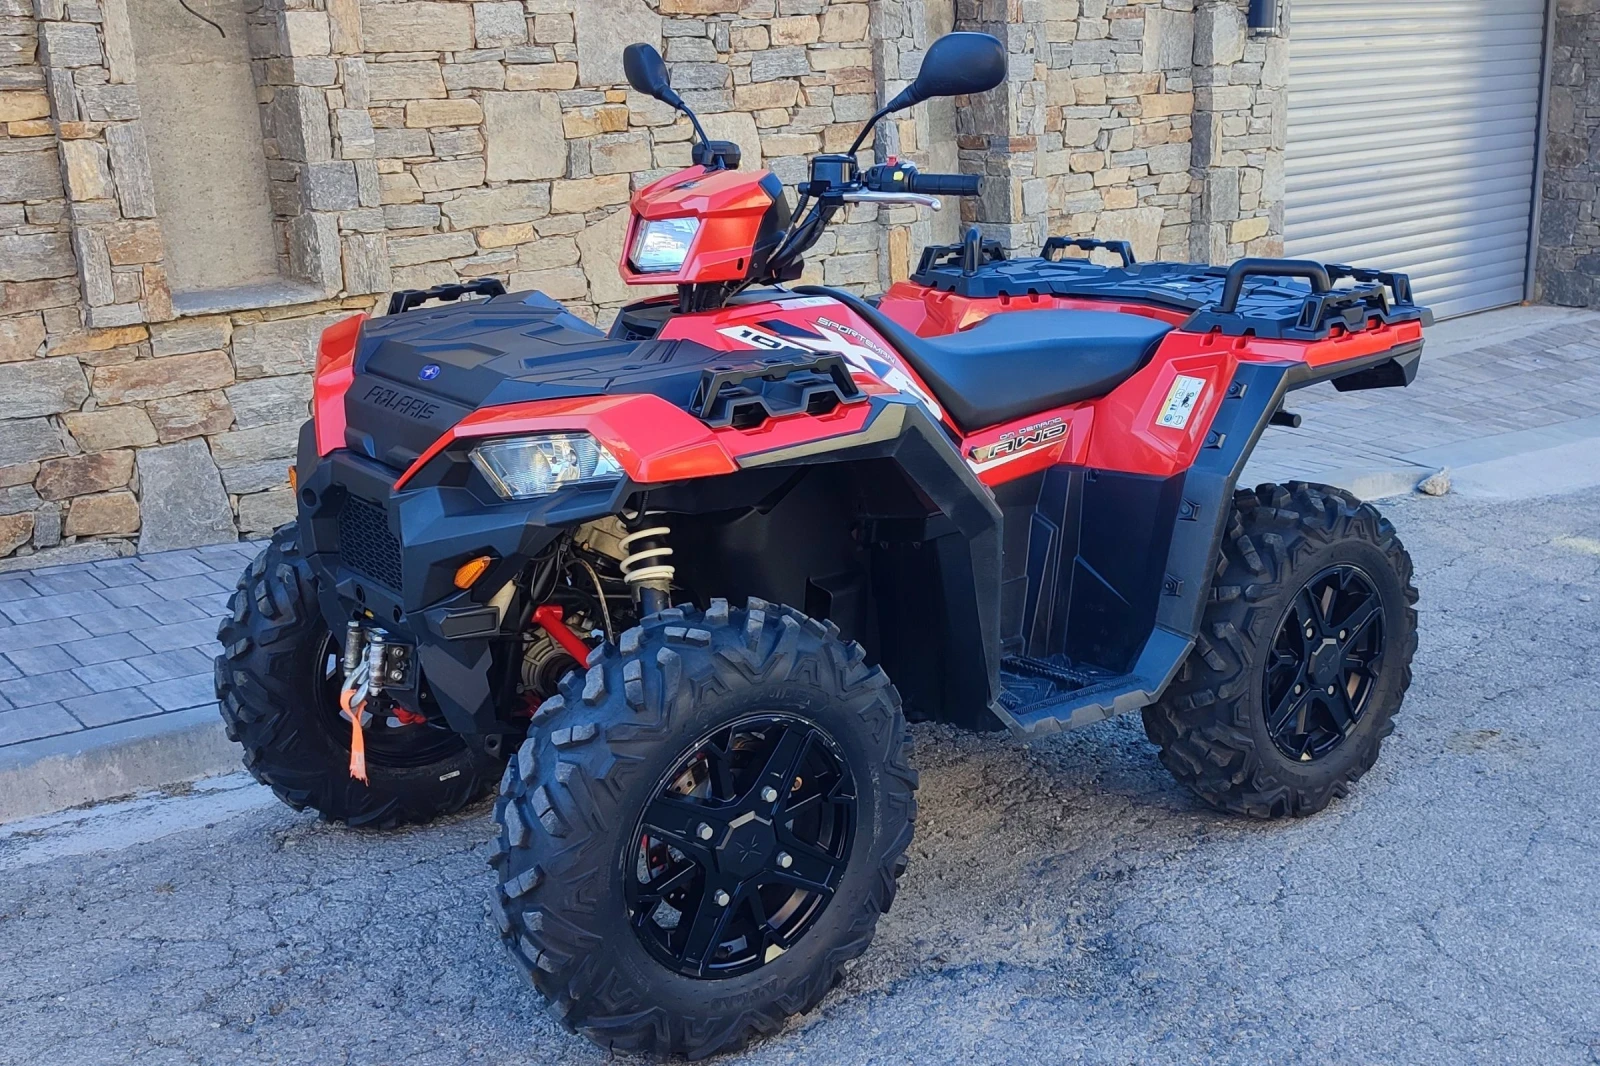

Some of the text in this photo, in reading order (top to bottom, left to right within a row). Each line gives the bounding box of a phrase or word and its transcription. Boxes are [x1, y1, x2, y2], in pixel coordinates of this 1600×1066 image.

[816, 316, 898, 364] SPORTSMAN
[363, 385, 441, 420] POLARIS
[987, 422, 1068, 460] AWD
